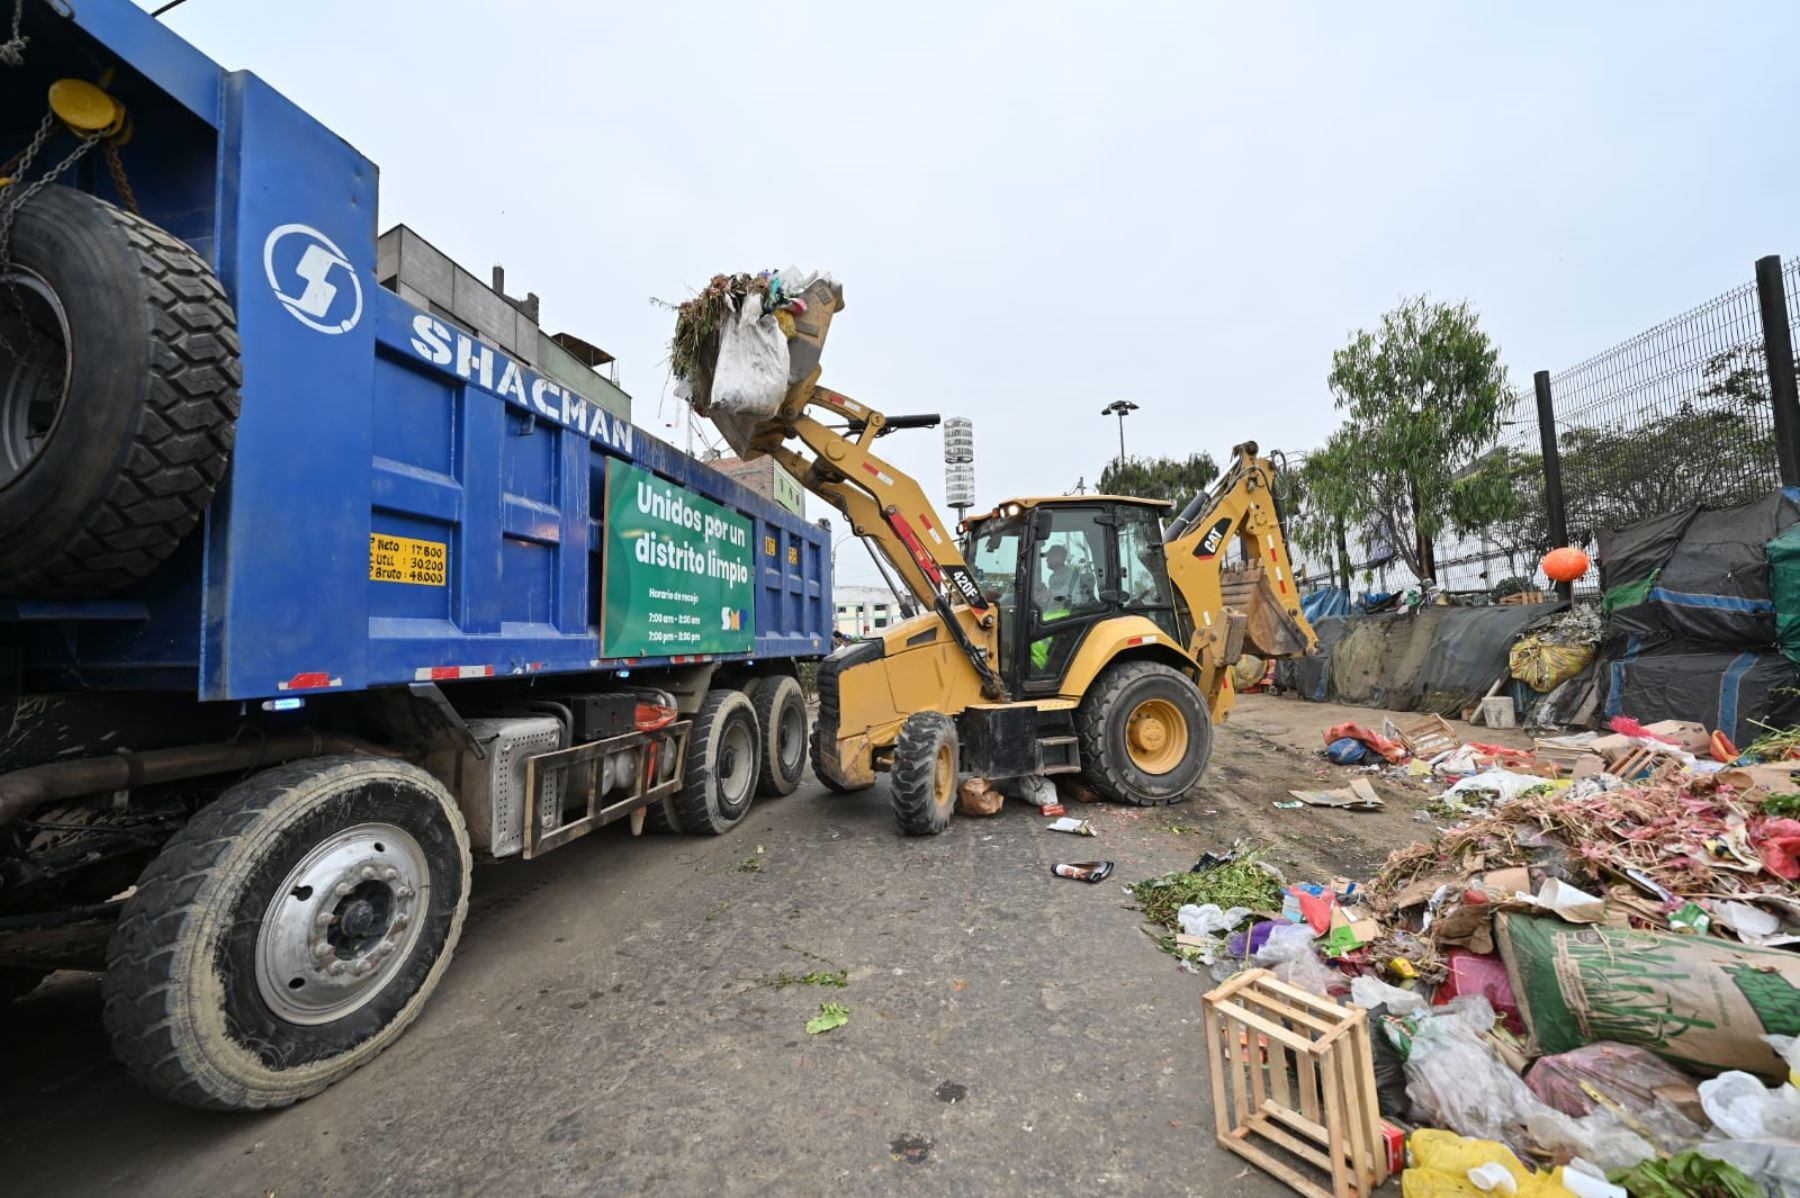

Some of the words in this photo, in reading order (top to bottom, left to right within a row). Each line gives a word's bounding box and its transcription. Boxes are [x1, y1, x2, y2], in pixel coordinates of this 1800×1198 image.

[410, 314, 633, 453] SHACMAN
[637, 481, 702, 532] Unidos
[704, 514, 729, 543] por
[729, 525, 746, 547] un
[377, 539, 400, 552] Neto
[1204, 527, 1223, 553] CAT
[410, 557, 444, 572] 30.200
[635, 531, 705, 574] distrito
[707, 549, 748, 589] limpio
[375, 567, 402, 580] Bruto
[409, 571, 443, 583] 48.000
[953, 571, 978, 597] 420F
[649, 587, 674, 600] Horario
[674, 591, 681, 600] de
[721, 606, 749, 631] SMP
